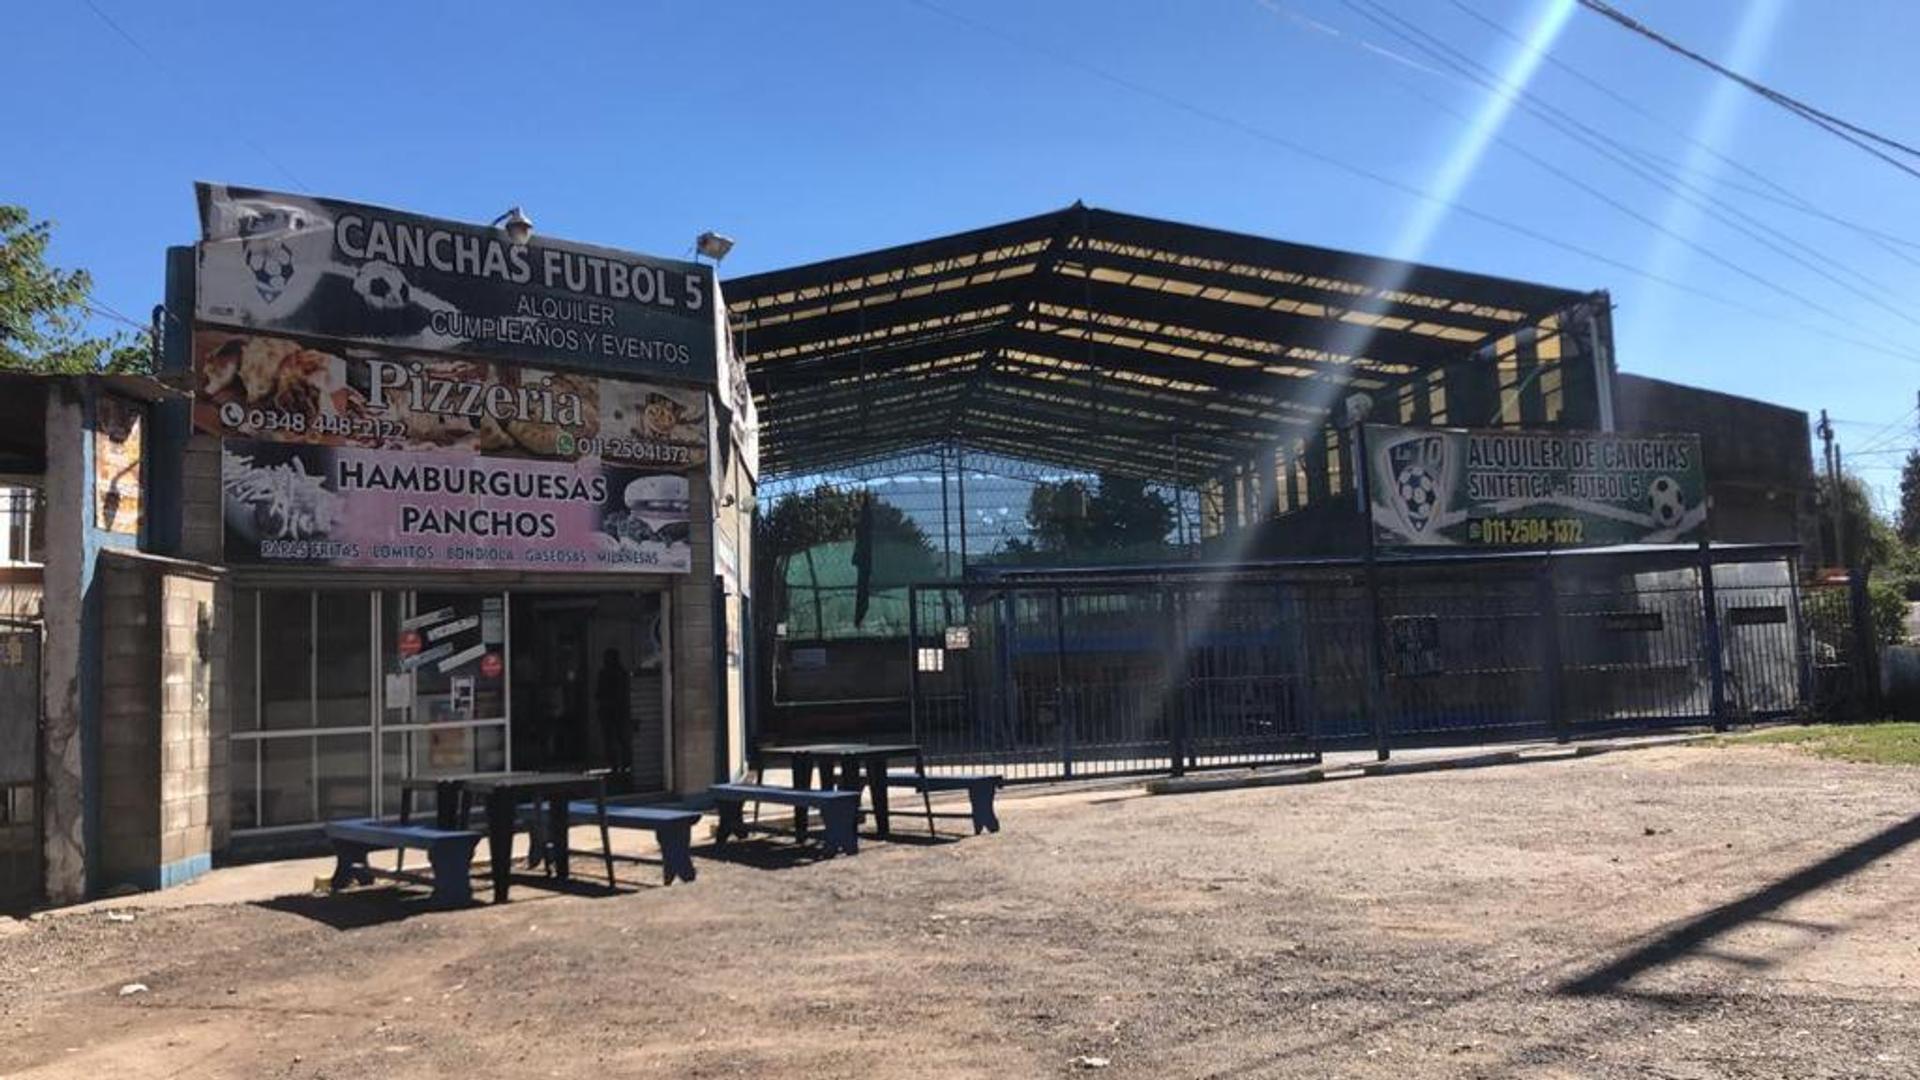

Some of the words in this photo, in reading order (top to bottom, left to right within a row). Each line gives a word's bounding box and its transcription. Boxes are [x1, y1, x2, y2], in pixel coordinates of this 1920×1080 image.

[337, 215, 531, 284] CANCHAS
[544, 250, 675, 307] FUTBOL
[686, 274, 703, 310] 5
[517, 294, 615, 326] ALQUILER
[431, 311, 579, 350] CUMPLEAÑOS
[583, 332, 598, 351] Y
[602, 334, 690, 364] EVENTOS
[365, 360, 584, 426] Pizzeria
[249, 409, 305, 432] 0348
[311, 416, 407, 441] 448-2122
[1469, 437, 1565, 468] ALQUILER
[1571, 440, 1597, 469] DE
[1602, 441, 1689, 469] CANCHAS
[338, 460, 606, 502] HAMBURGUESAS
[1469, 473, 1553, 499] SINTETICA
[1570, 475, 1627, 499] FUTBOL
[1630, 476, 1641, 499] 5
[402, 507, 556, 538] PANCHOS
[1483, 519, 1585, 544] 011-2504-1372
[260, 540, 308, 558] PAPAS
[373, 543, 434, 559] LOMITOS
